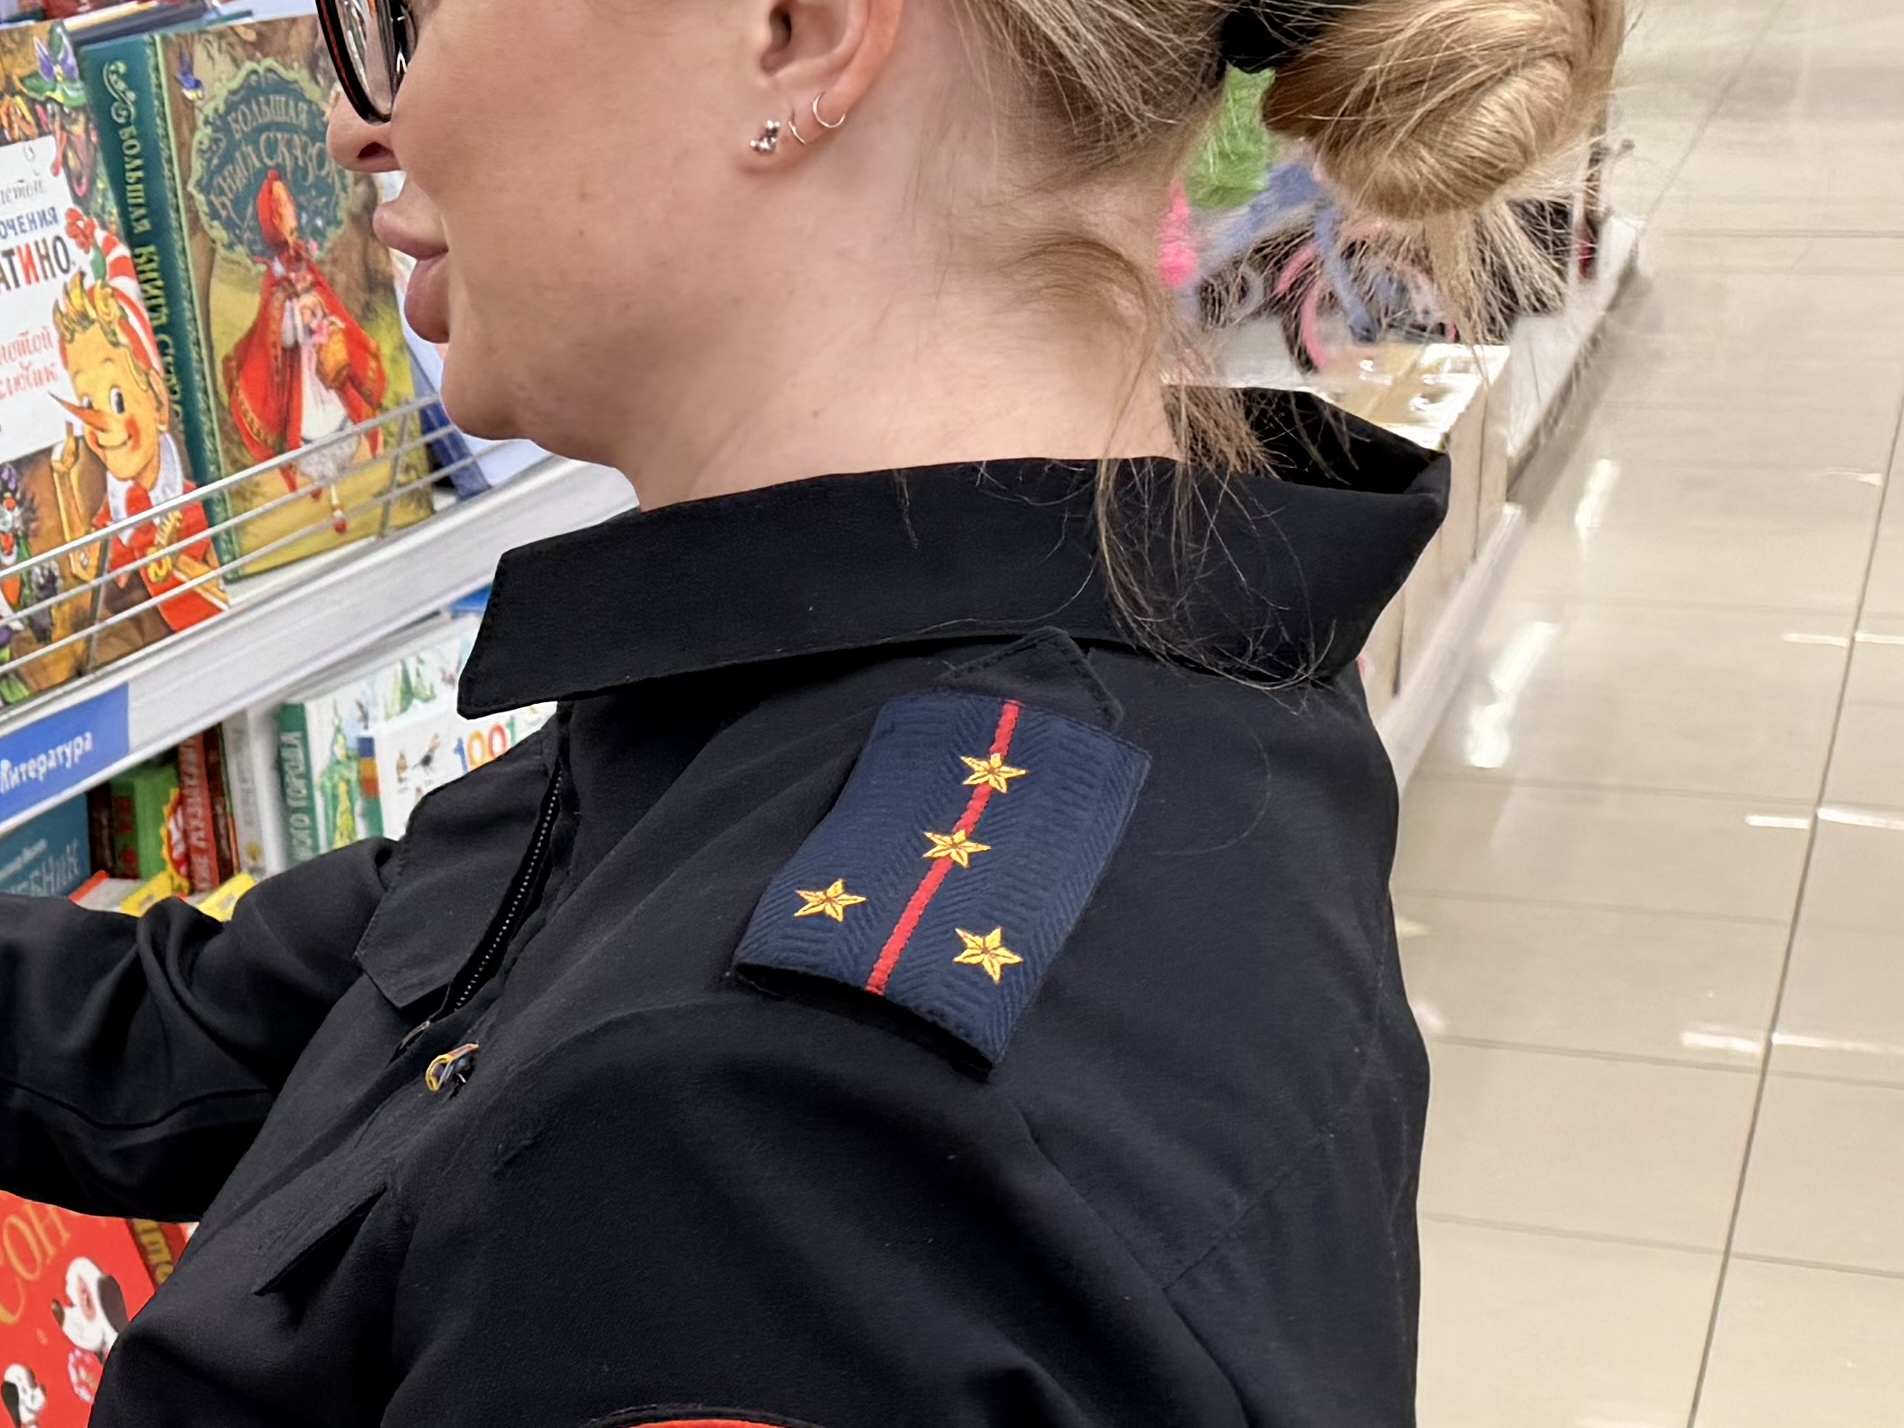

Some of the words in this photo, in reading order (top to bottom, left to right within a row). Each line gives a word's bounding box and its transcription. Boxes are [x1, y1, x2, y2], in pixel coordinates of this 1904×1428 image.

[226, 93, 311, 136] БОЛЬШАЯ
[118, 125, 155, 235] БОЛЬШАЯ
[134, 243, 169, 329] КНИГА
